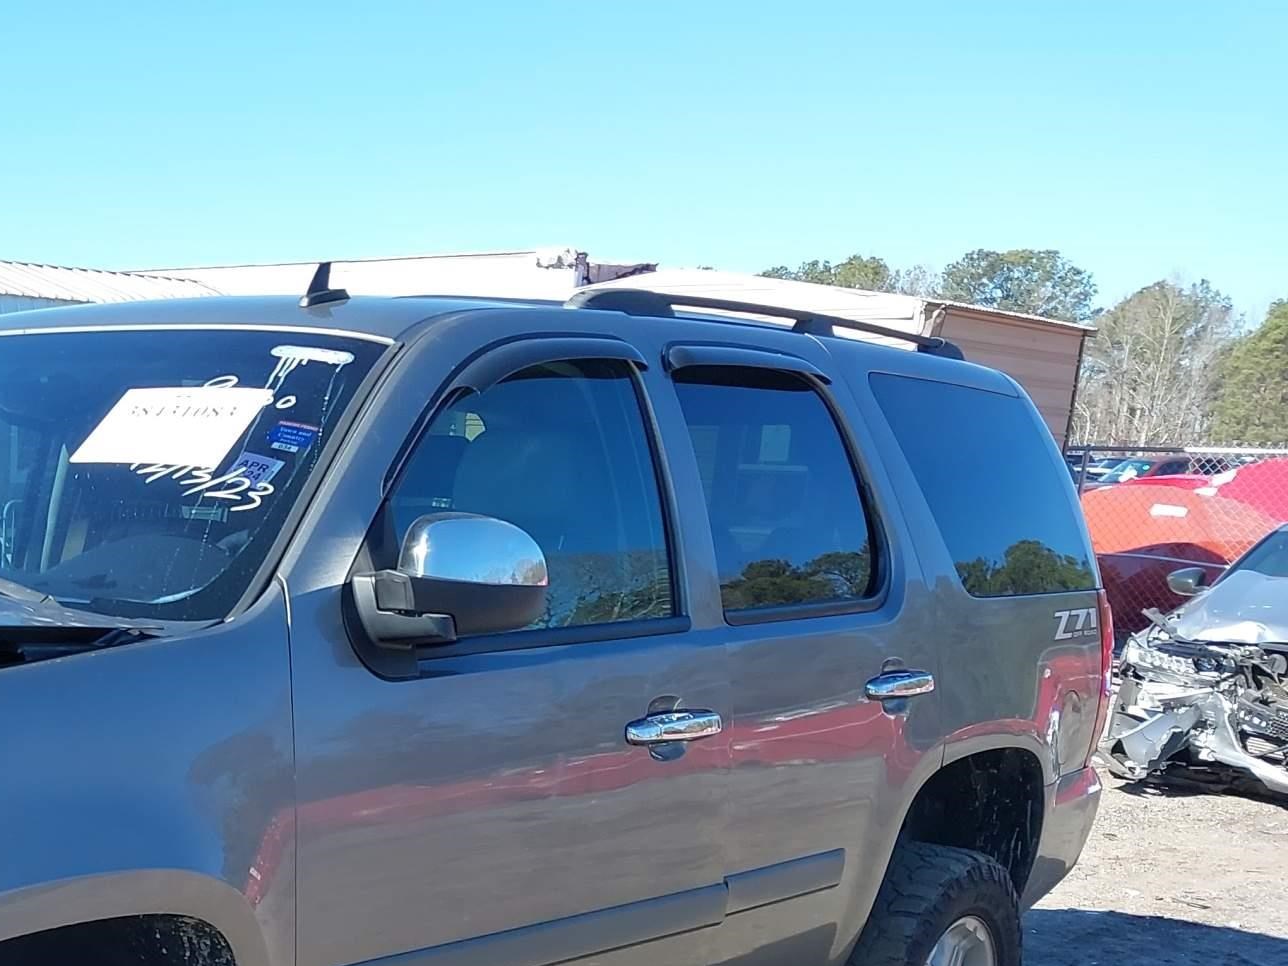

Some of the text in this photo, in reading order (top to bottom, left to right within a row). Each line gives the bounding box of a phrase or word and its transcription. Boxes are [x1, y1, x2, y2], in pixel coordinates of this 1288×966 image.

[239, 460, 269, 472] APR
[247, 470, 261, 481] 24
[1054, 607, 1097, 641] Z71
